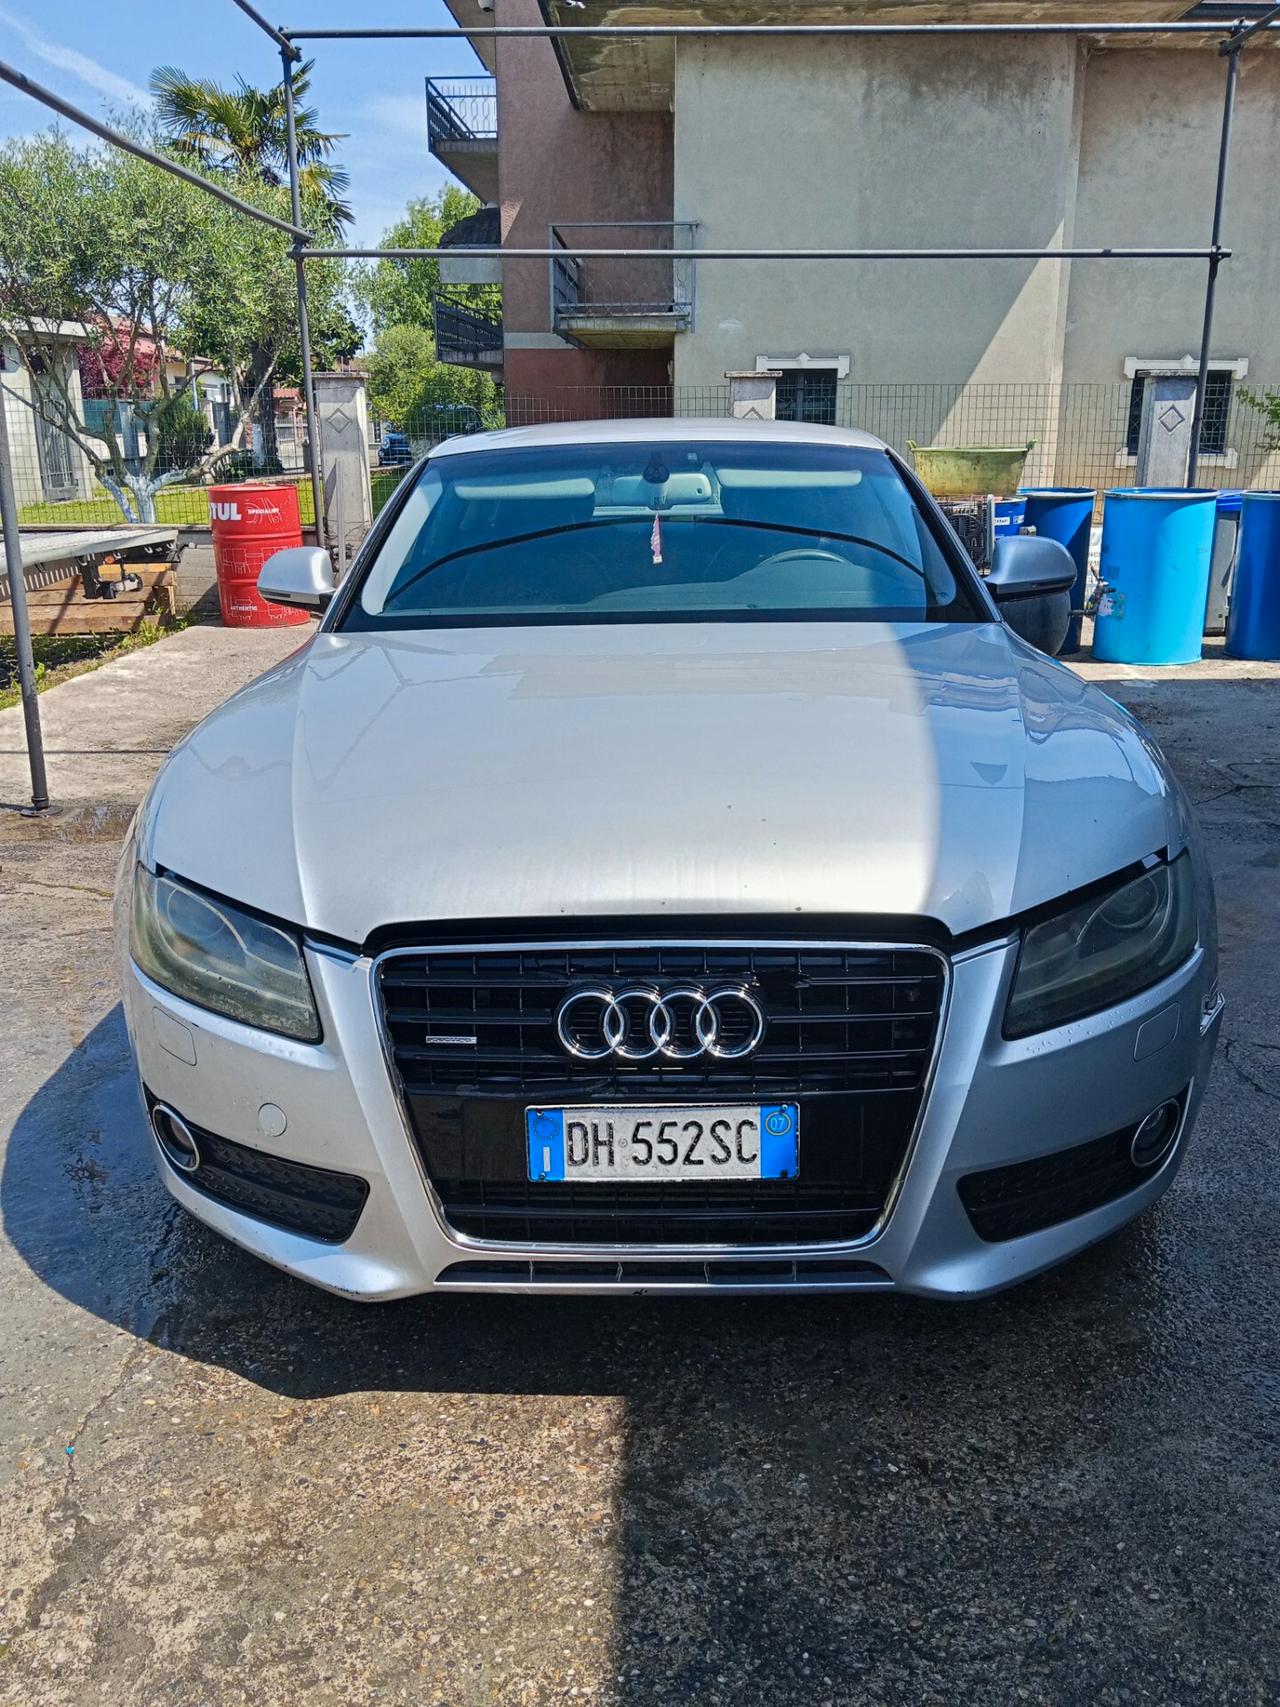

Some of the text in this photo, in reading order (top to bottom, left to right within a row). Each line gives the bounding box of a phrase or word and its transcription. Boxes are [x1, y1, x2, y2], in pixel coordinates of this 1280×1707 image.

[208, 502, 242, 521] TUL
[769, 1116, 785, 1131] 07
[567, 1119, 758, 1166] DH 552SC
[542, 1146, 551, 1172] I
